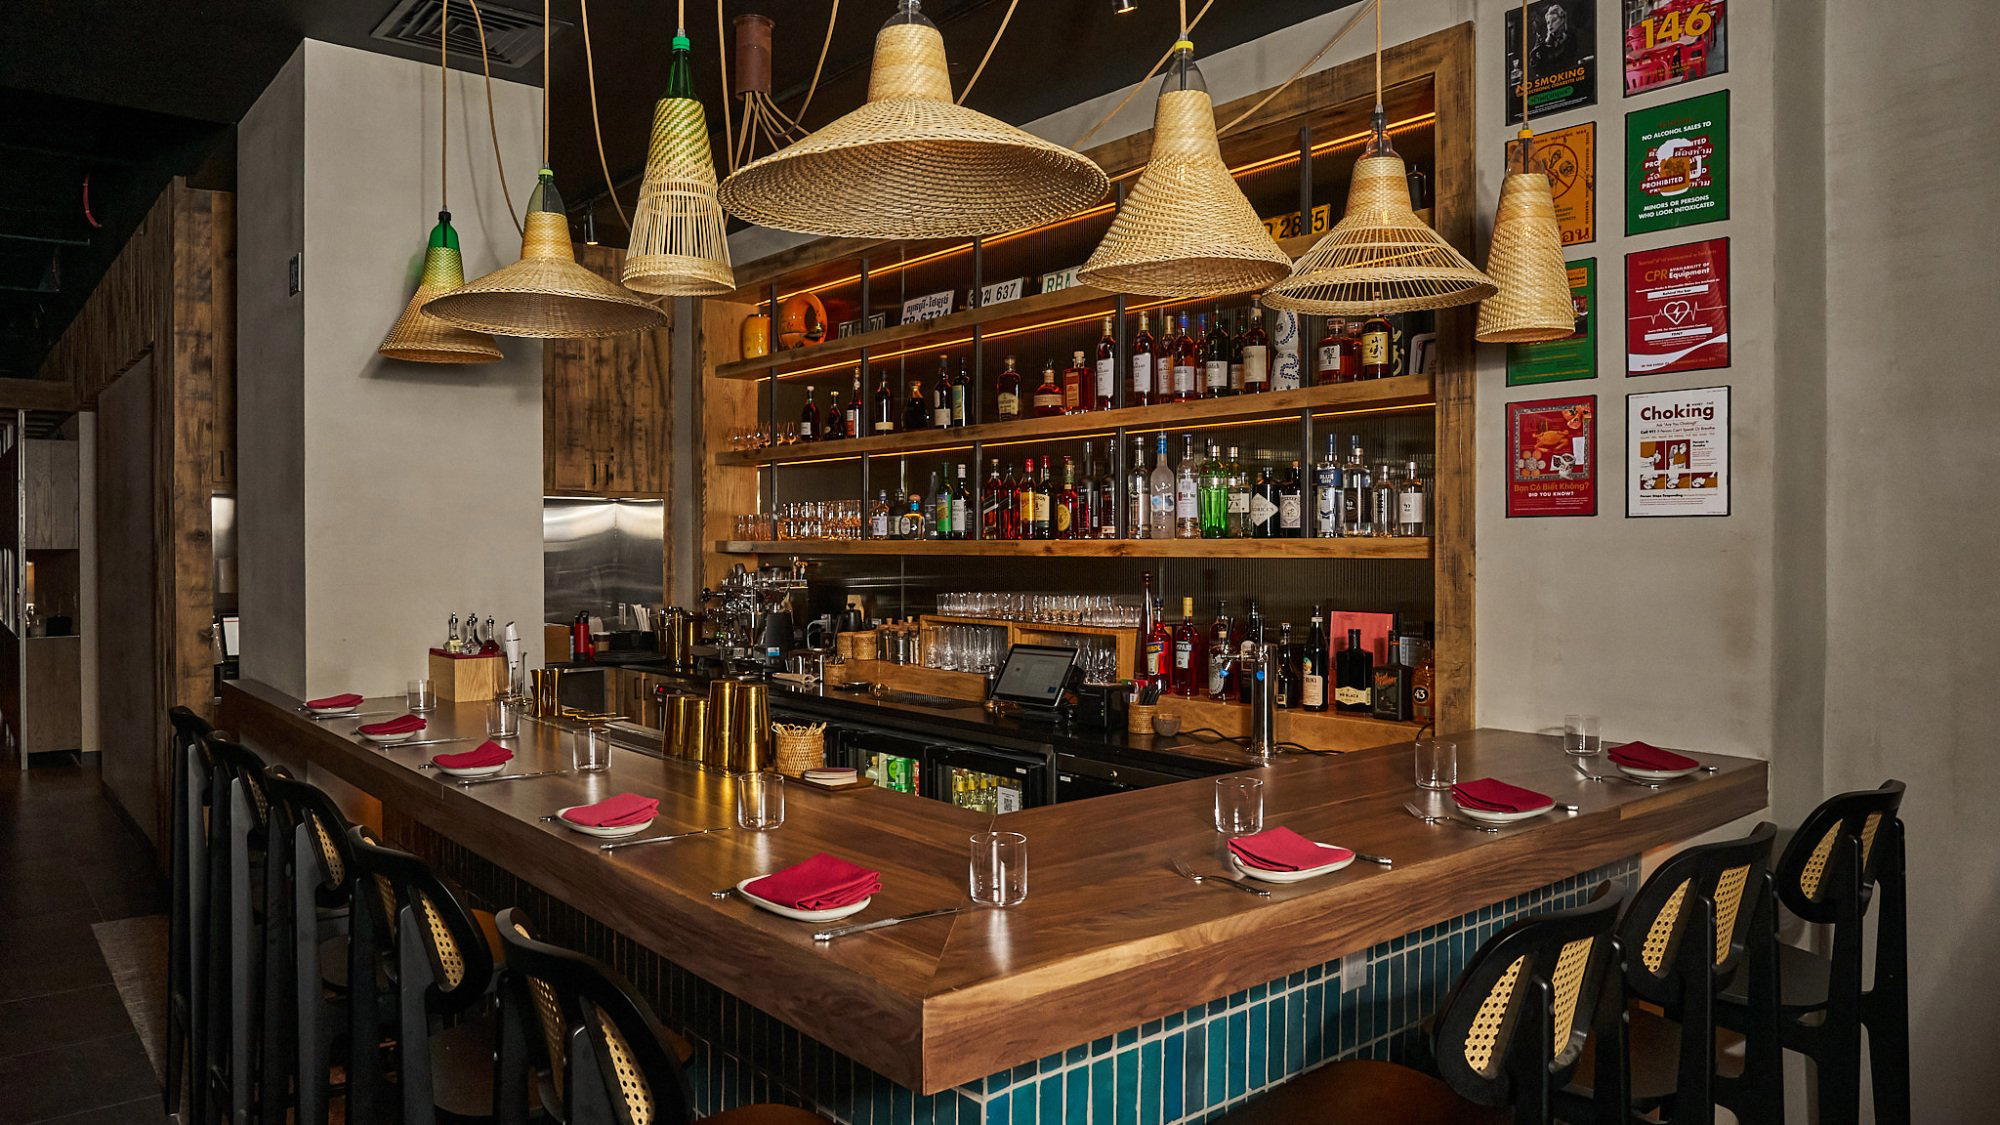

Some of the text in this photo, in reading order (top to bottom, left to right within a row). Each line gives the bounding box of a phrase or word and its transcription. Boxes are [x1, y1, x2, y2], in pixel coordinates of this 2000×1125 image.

[1641, 3, 1711, 48] 146
[1534, 67, 1585, 87] SMOKING
[1653, 127, 1682, 139] ALCOHOL
[1683, 123, 1702, 132] SALES
[1641, 176, 1684, 189] PROHIBITED
[1643, 201, 1669, 211] MINORS
[1680, 195, 1710, 205] PERSONS
[1655, 208, 1674, 216] LOOK
[1674, 201, 1715, 213] INTOXICATED
[1645, 269, 1668, 282] CPR
[1669, 267, 1710, 280] Equipment
[996, 283, 1017, 301] 637
[1640, 403, 1714, 420] Choking
[1414, 689, 1426, 699] 43
